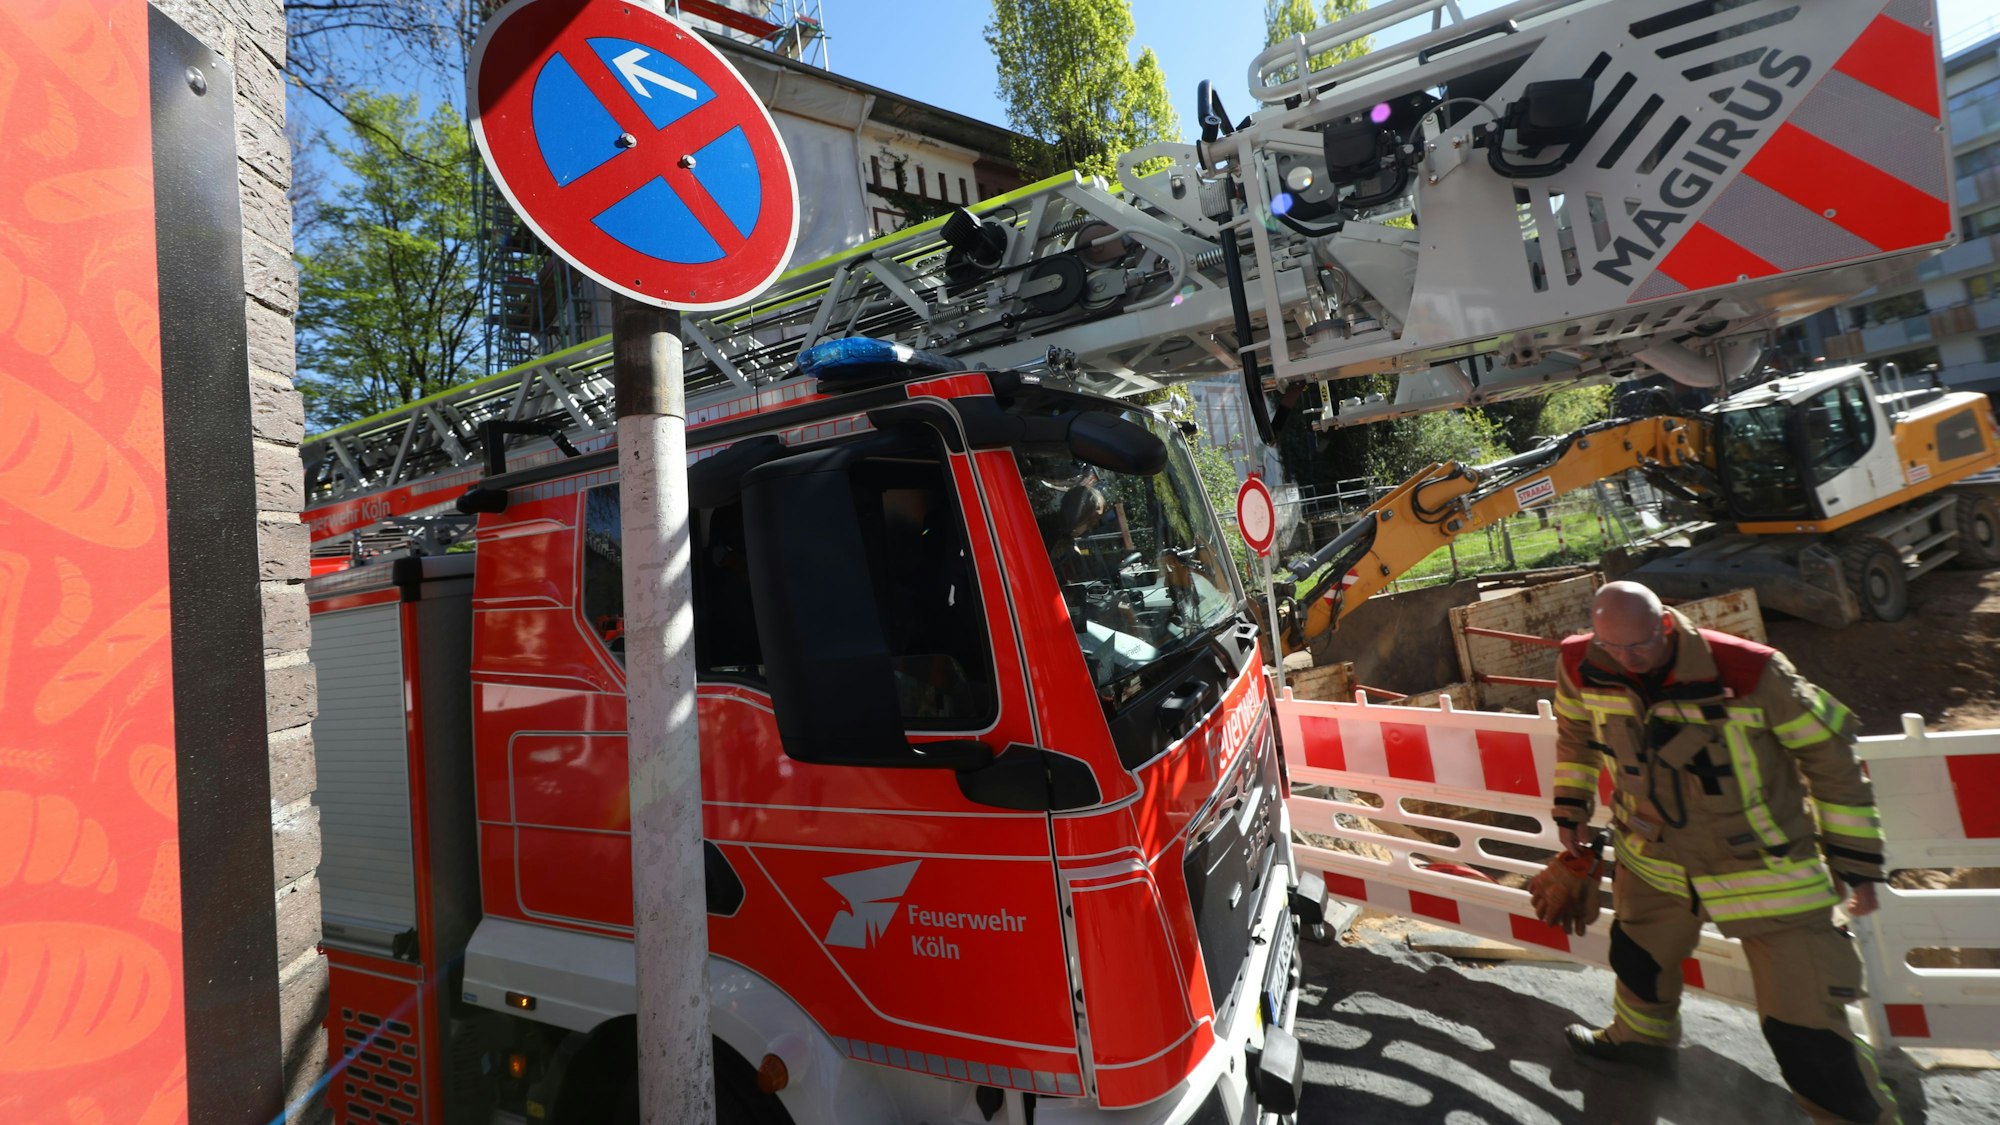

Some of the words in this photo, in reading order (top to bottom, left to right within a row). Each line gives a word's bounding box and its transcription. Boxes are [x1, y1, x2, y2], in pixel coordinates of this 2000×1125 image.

[1592, 48, 1812, 287] MAGIRUS
[1518, 482, 1552, 502] STRABAG
[308, 504, 359, 533] uerwehr
[361, 497, 391, 521] Köln
[1206, 670, 1262, 783] Feuerwehr
[907, 903, 1027, 932] Feuerwehr
[911, 934, 961, 960] Köln
